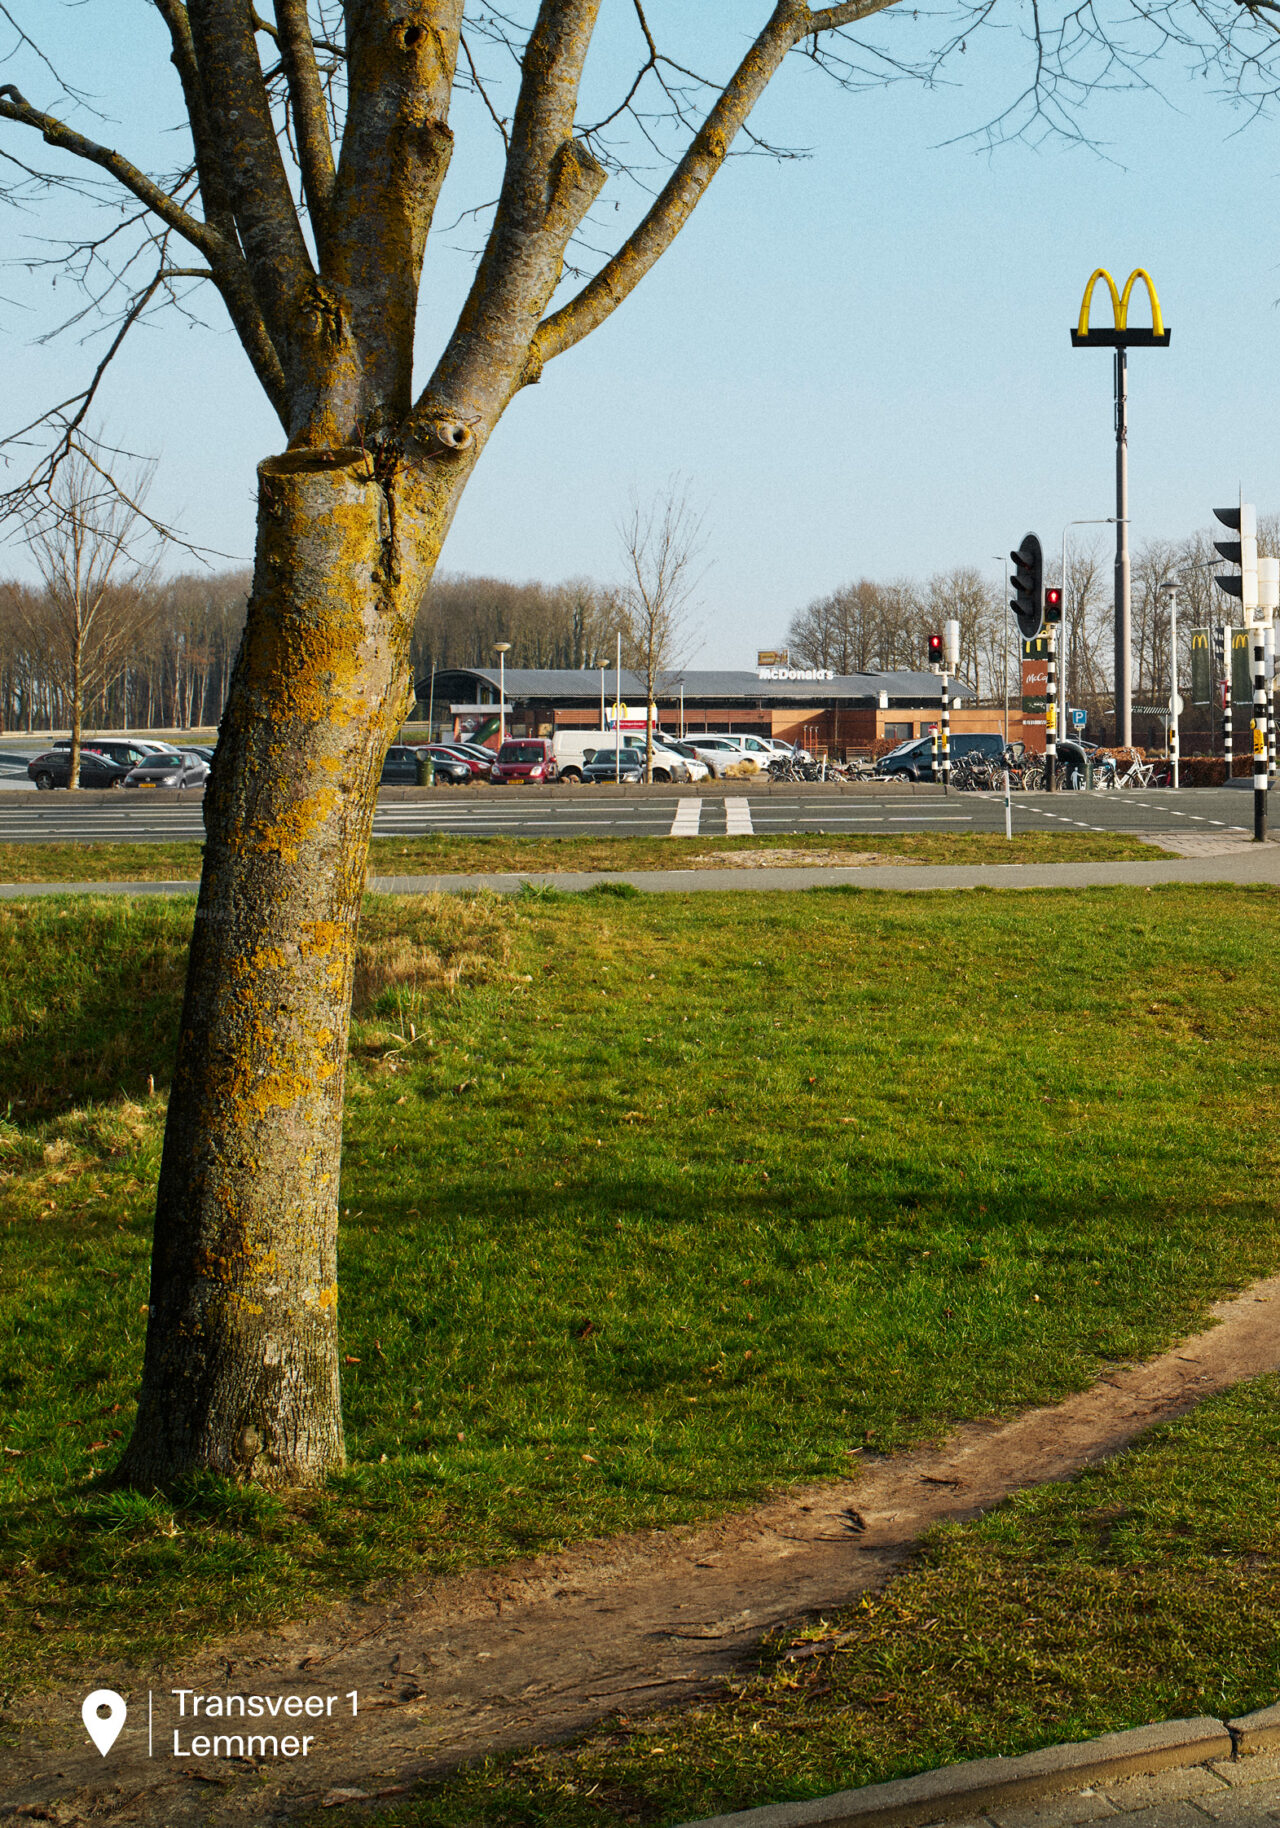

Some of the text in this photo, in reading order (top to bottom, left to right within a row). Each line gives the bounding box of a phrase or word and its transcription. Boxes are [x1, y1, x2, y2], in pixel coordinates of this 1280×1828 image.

[759, 669, 834, 680] McDonald's
[1026, 672, 1048, 683] McCa
[1075, 712, 1084, 722] P
